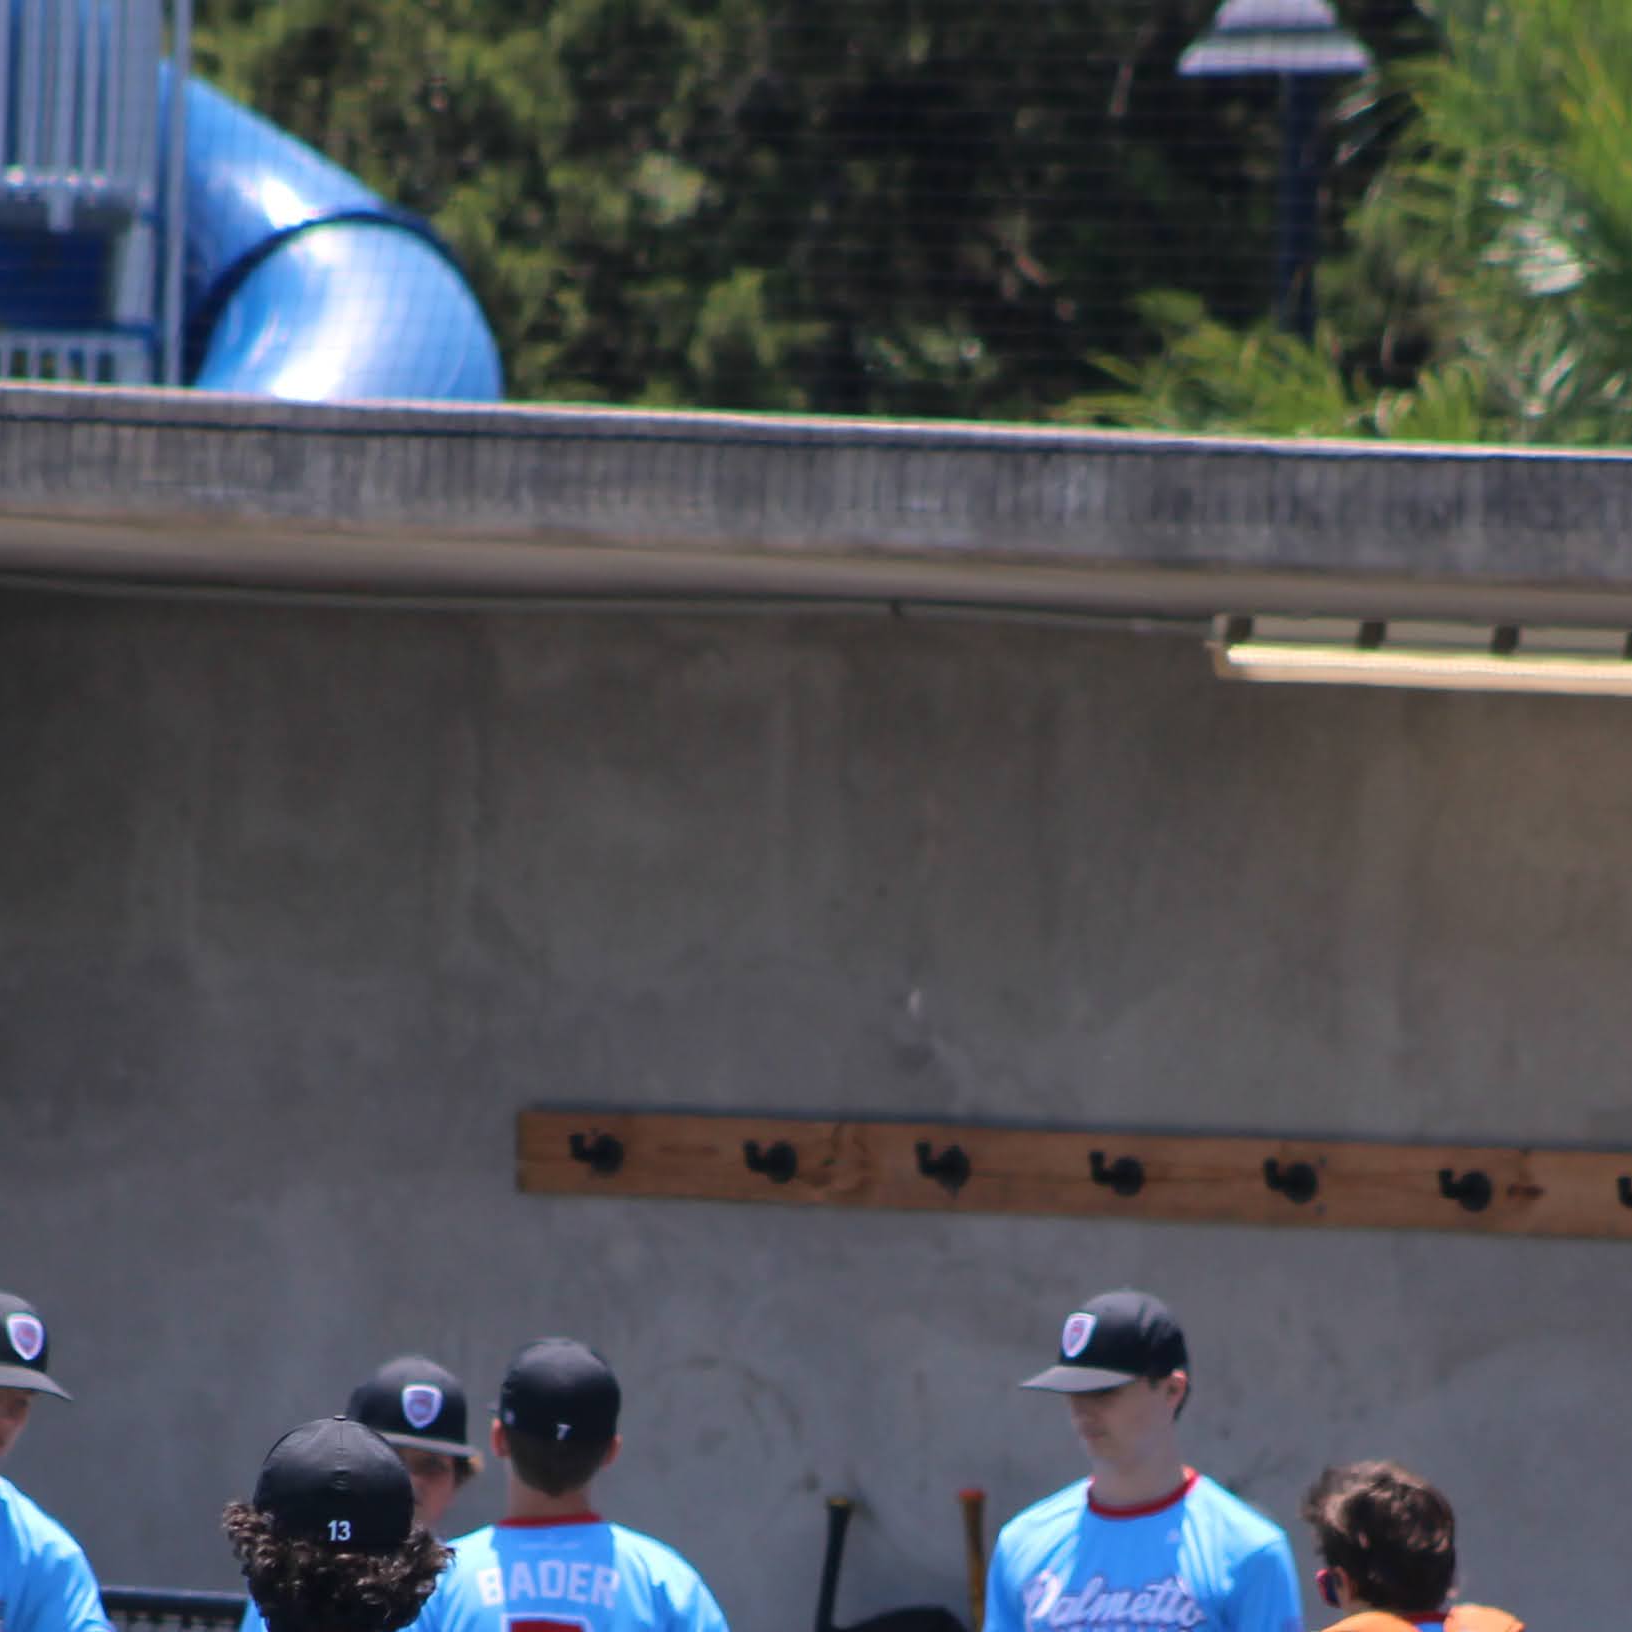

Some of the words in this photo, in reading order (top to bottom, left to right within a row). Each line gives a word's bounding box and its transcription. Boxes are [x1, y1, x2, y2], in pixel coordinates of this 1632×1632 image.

[556, 1423, 571, 1441] 7
[327, 1519, 352, 1541] 13
[475, 1558, 621, 1610] BADER
